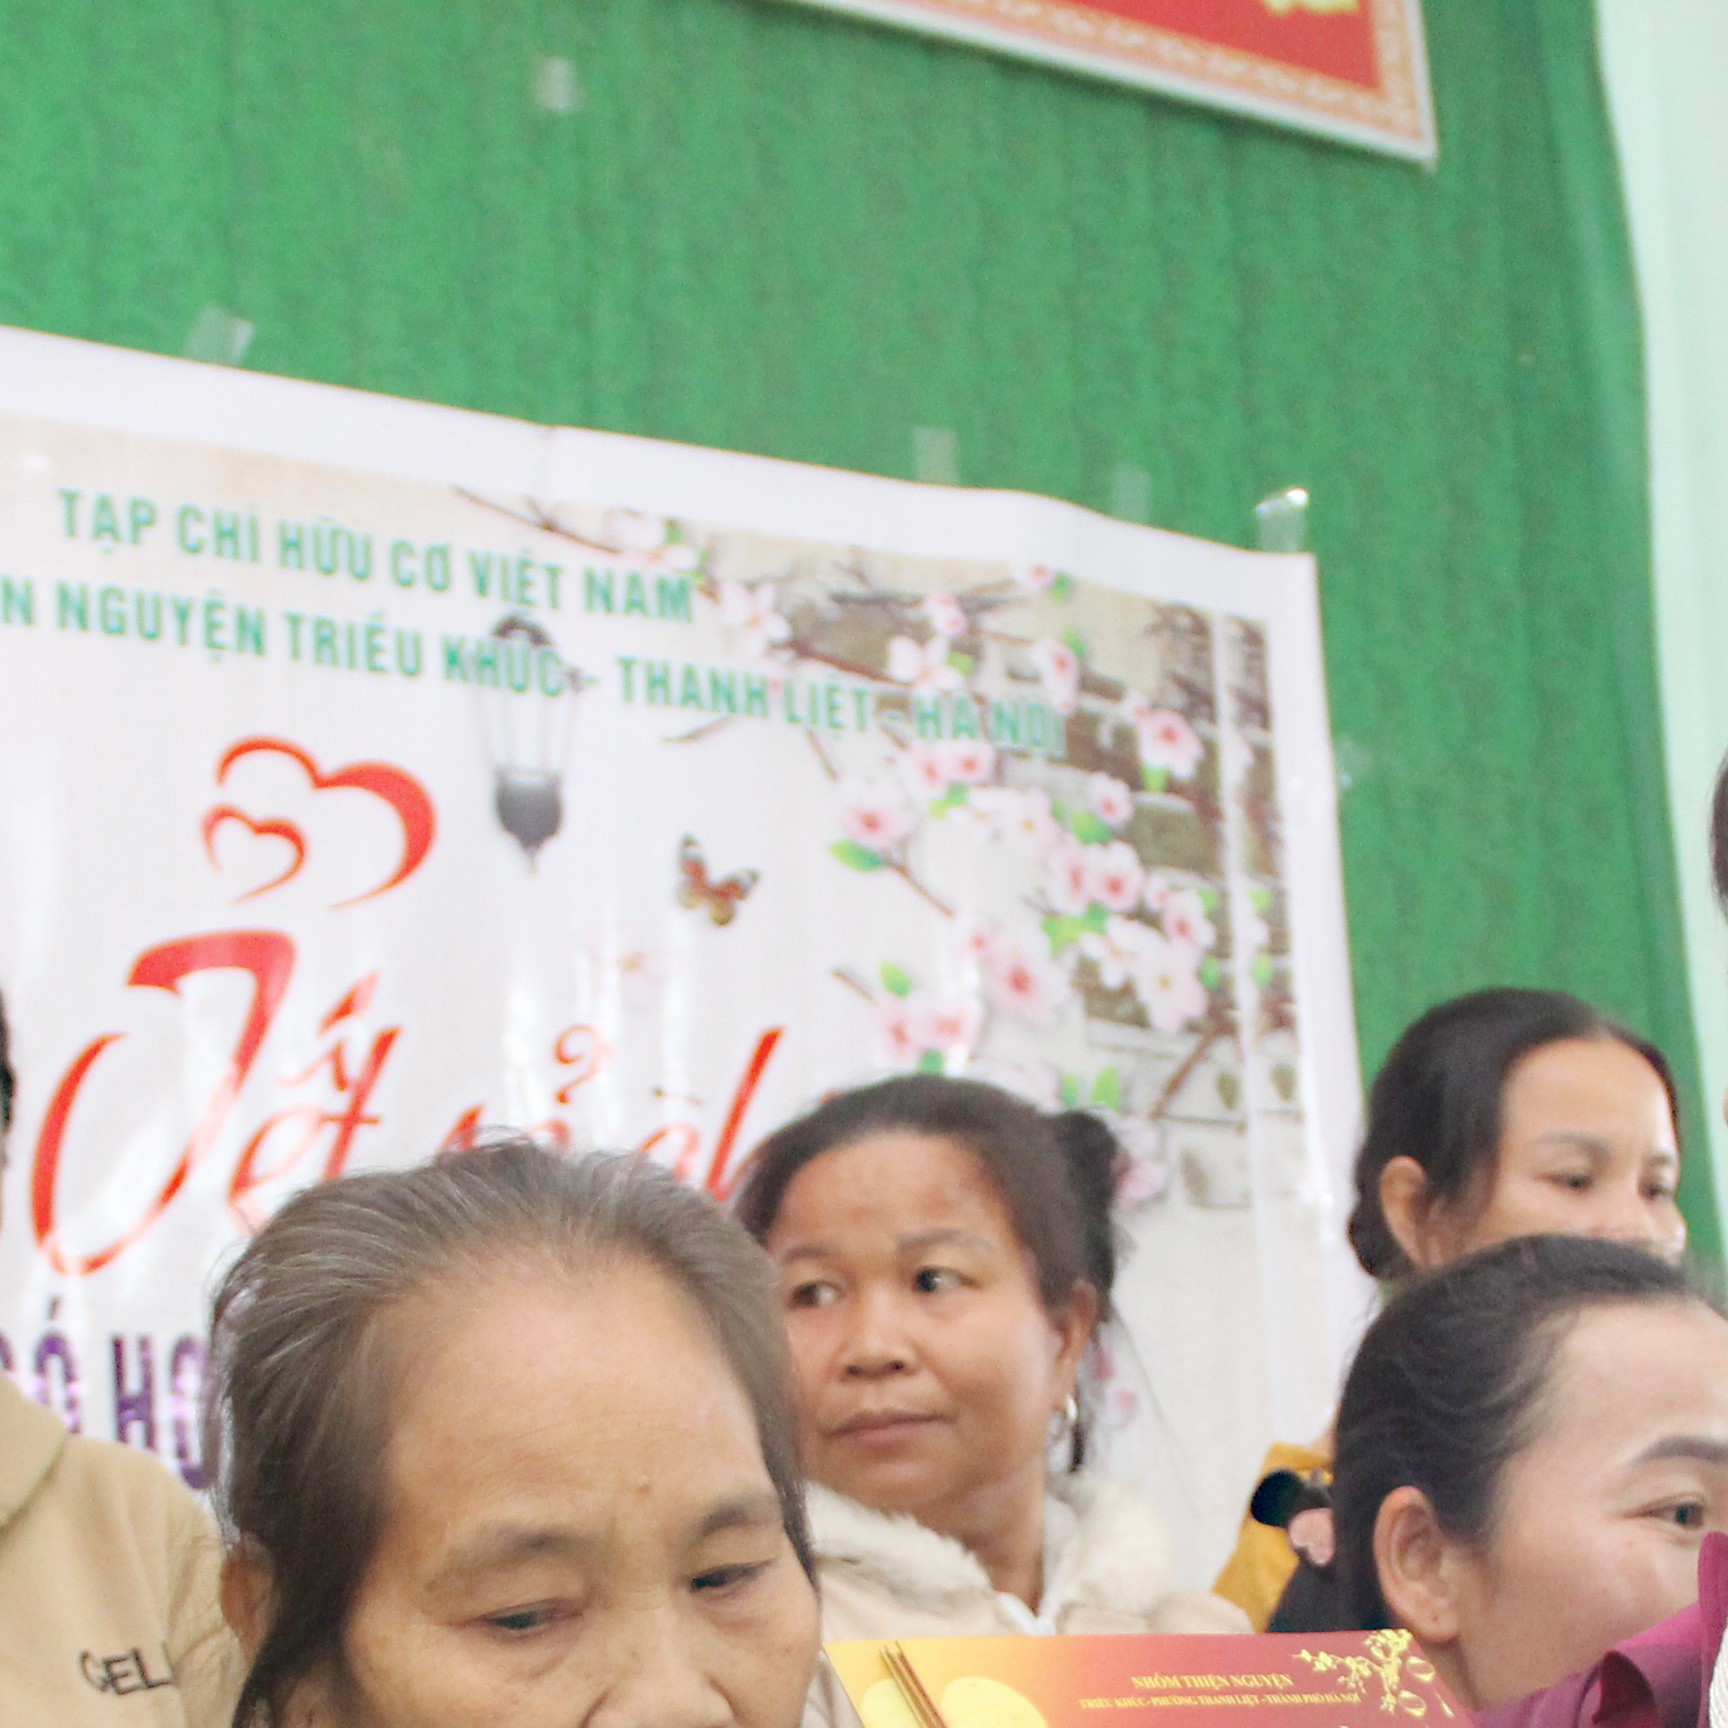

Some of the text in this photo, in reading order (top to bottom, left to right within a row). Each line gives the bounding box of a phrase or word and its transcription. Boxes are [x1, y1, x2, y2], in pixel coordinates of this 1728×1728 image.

[58, 487, 696, 625] TẠP CHÍ HỮU CƠ VIỆT NAM
[56, 582, 266, 663] NGUYỆN
[616, 654, 770, 722] THANH
